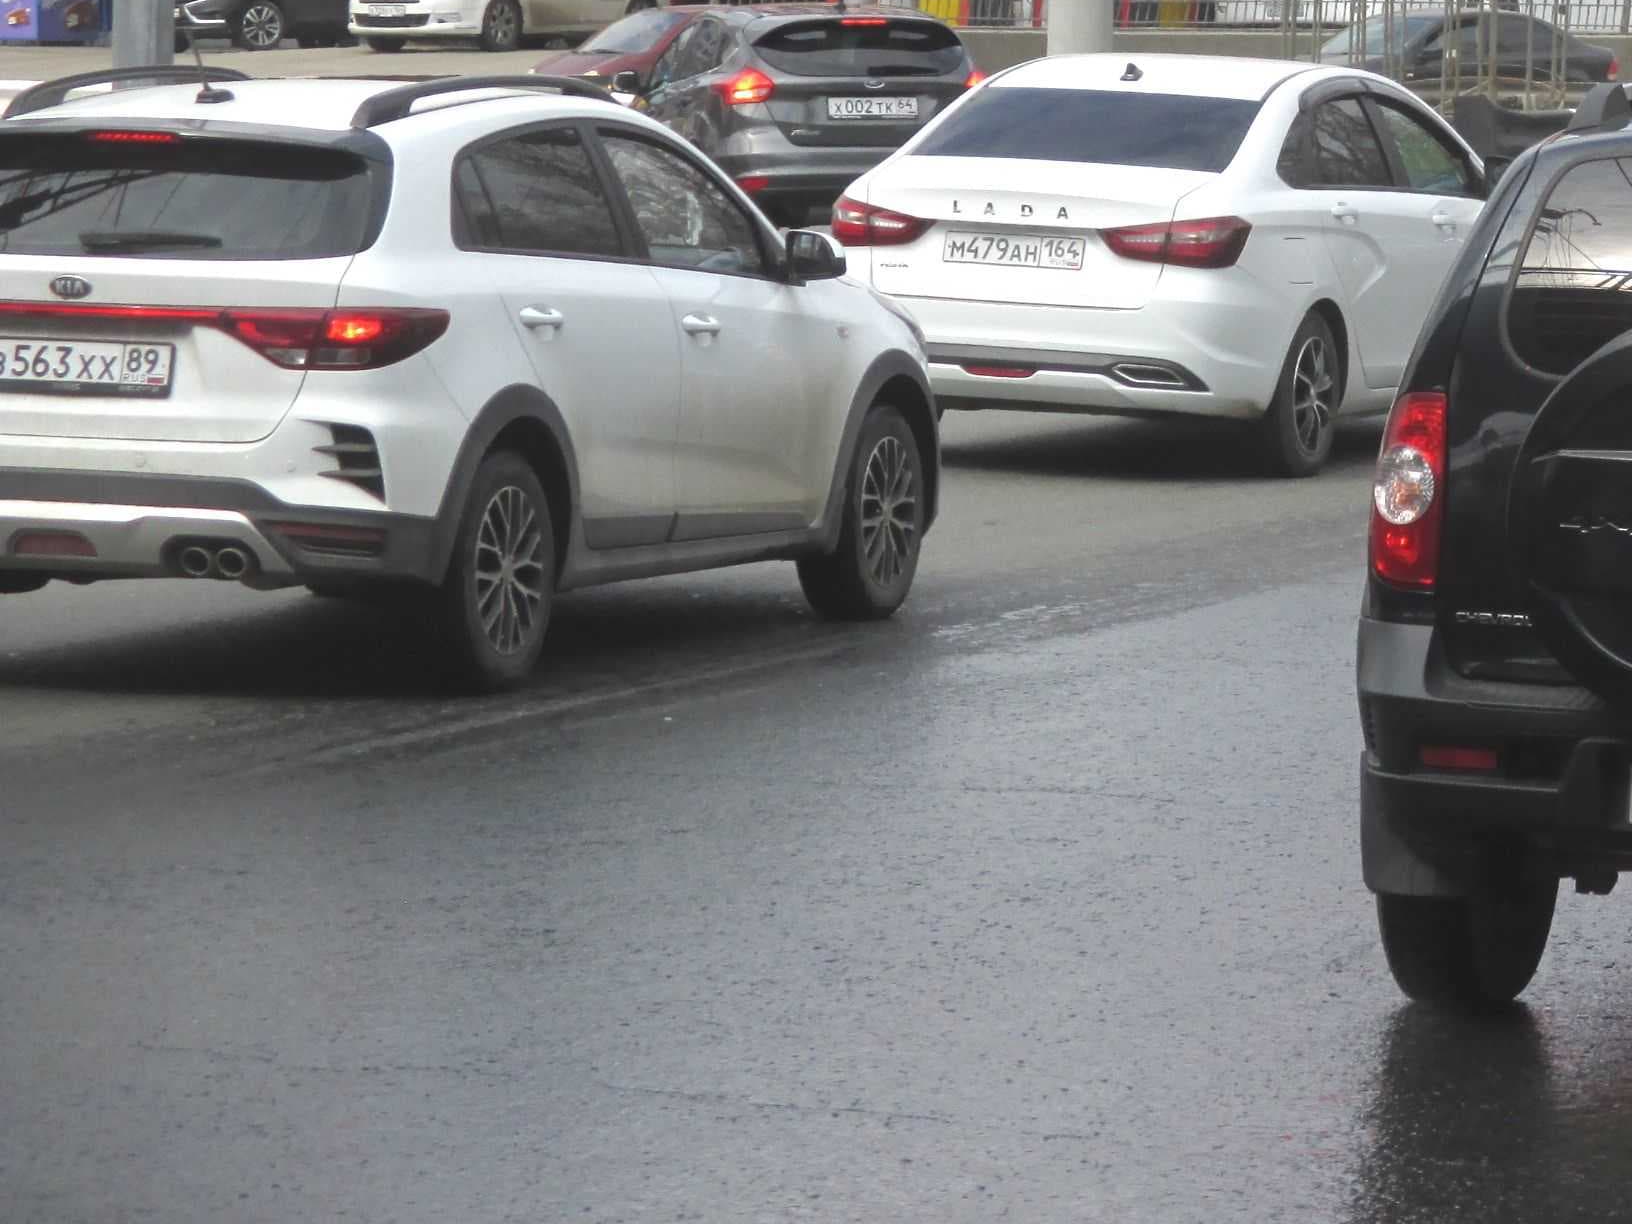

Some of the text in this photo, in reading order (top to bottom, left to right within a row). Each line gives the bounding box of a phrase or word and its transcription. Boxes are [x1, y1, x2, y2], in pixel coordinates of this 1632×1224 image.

[952, 200, 1069, 220] LADA
[950, 235, 1081, 264] М479АН 164
[55, 279, 85, 294] KIA
[126, 347, 161, 374] 89
